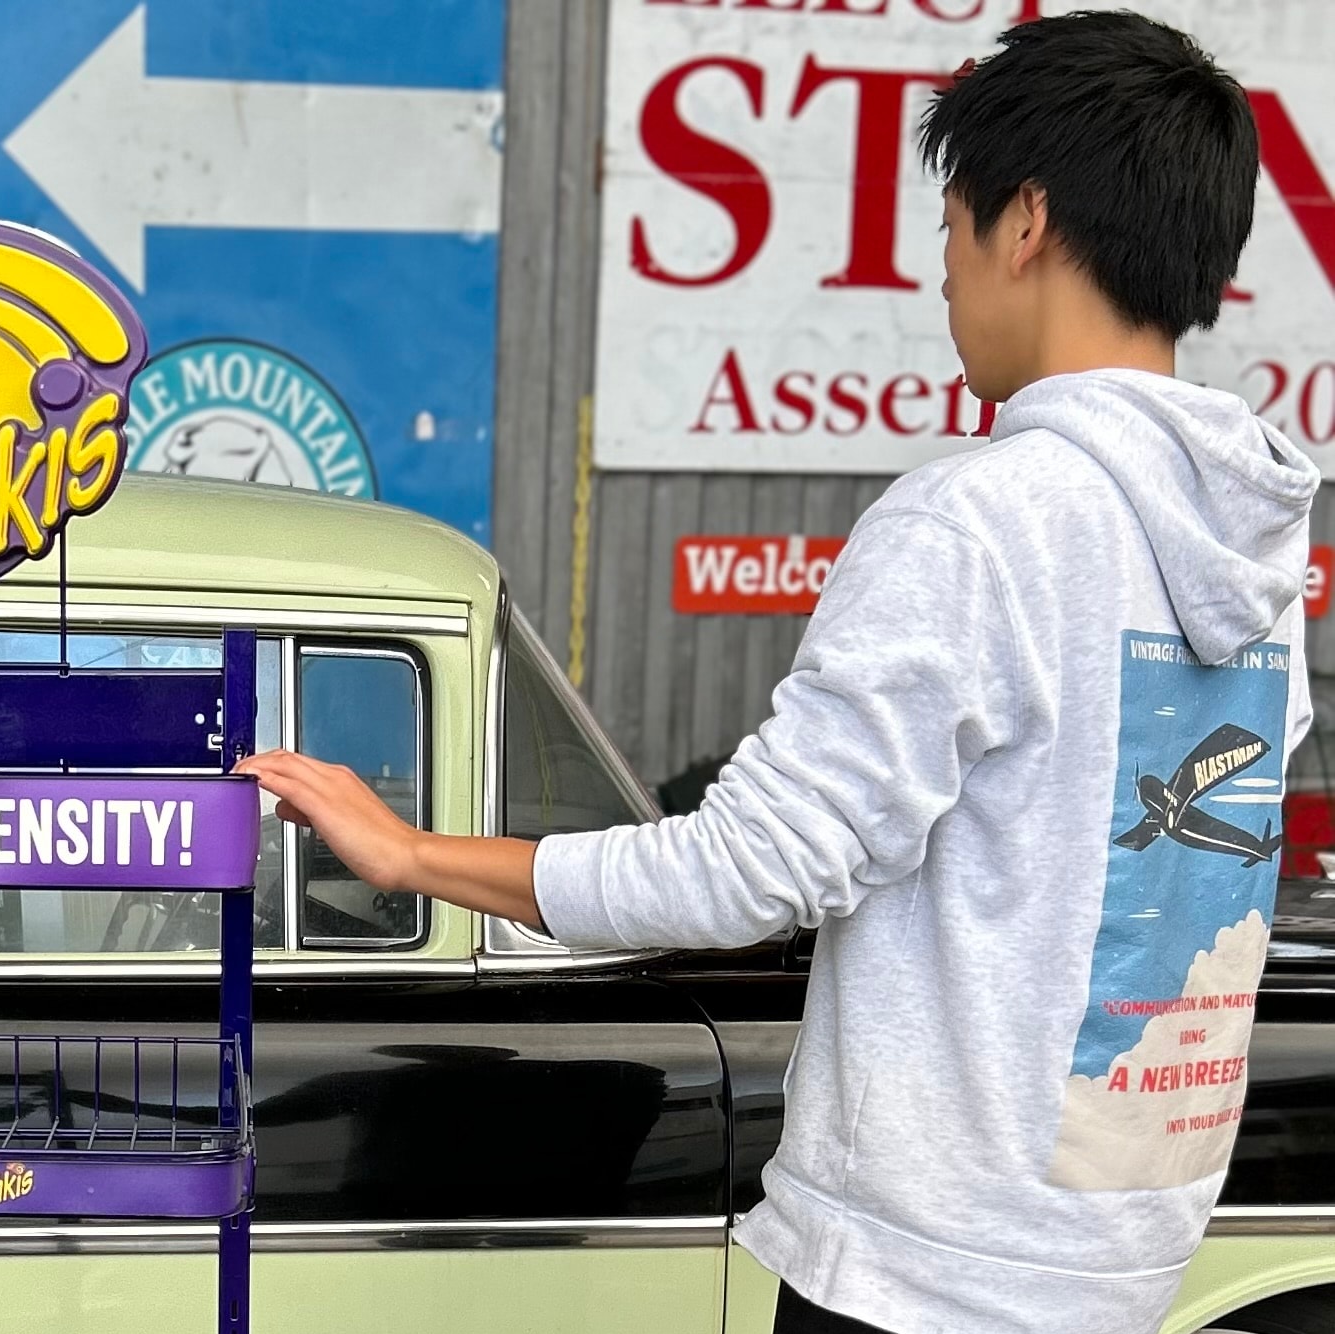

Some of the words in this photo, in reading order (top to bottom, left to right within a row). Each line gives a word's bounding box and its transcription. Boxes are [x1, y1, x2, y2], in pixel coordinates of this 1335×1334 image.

[1130, 639, 1174, 663] VINTAGE
[1243, 652, 1263, 669] IN
[1198, 995, 1220, 1011] AND
[1179, 1029, 1207, 1046] BRING
[1107, 1066, 1129, 1092] A
[1139, 1064, 1182, 1093] NEW
[1184, 1056, 1246, 1089] BREEZE
[1166, 1117, 1187, 1136] INTO
[1189, 1113, 1215, 1131] YOUR
